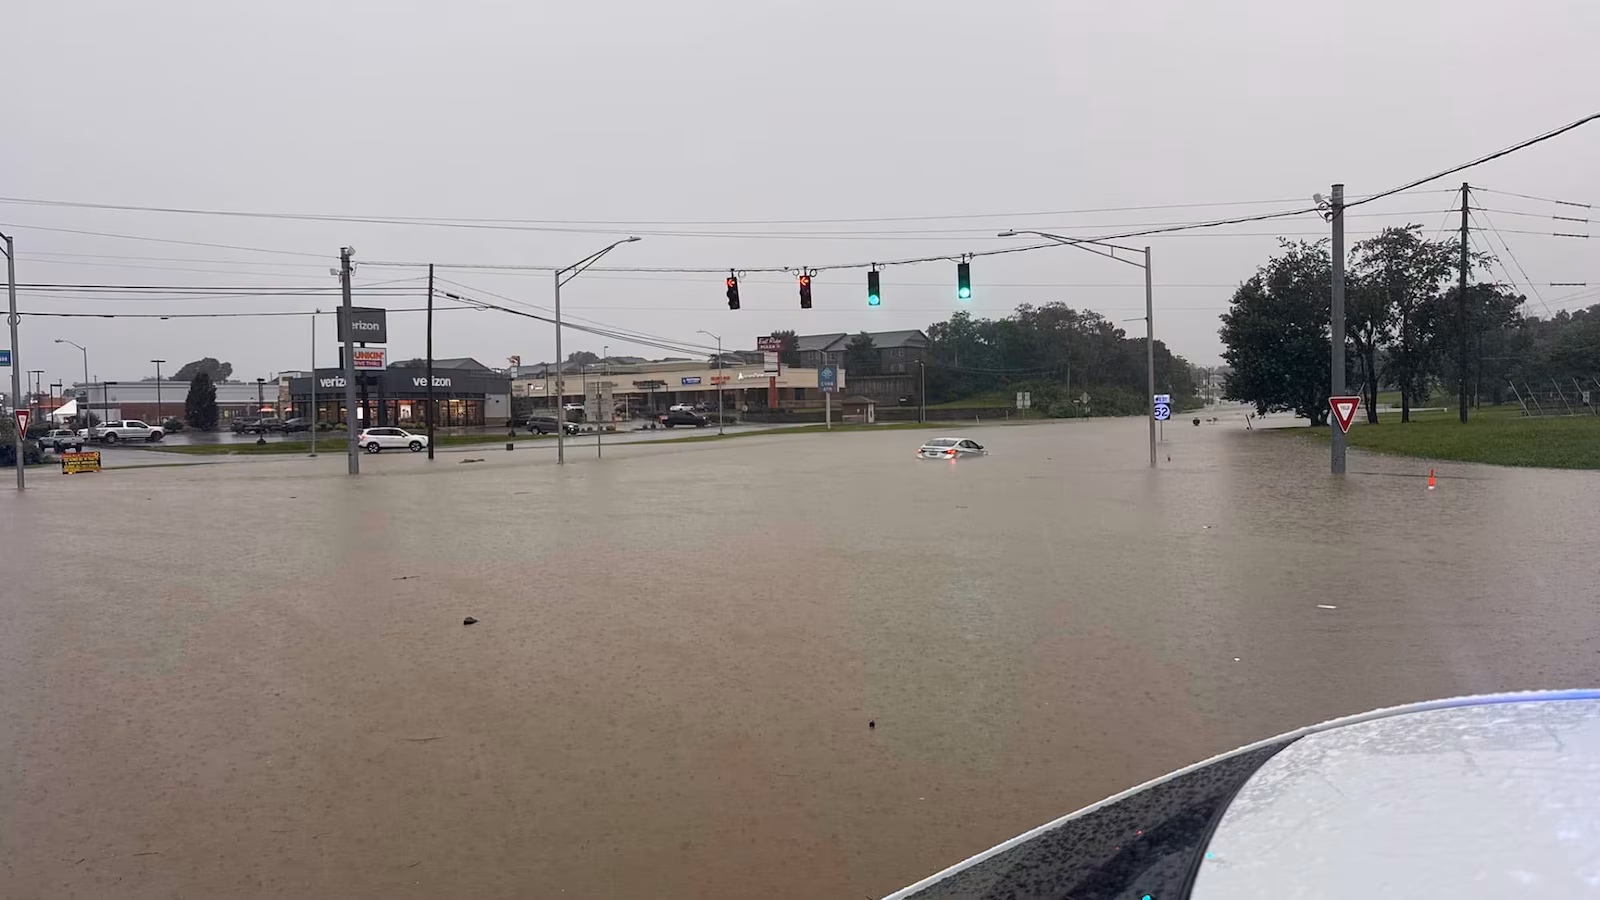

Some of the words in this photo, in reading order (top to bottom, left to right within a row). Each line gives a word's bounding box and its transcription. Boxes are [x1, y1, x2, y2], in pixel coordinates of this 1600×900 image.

[352, 320, 380, 330] erizon
[353, 351, 384, 359] UNKIN'
[412, 376, 451, 387] veizon
[1154, 407, 1168, 416] 52
